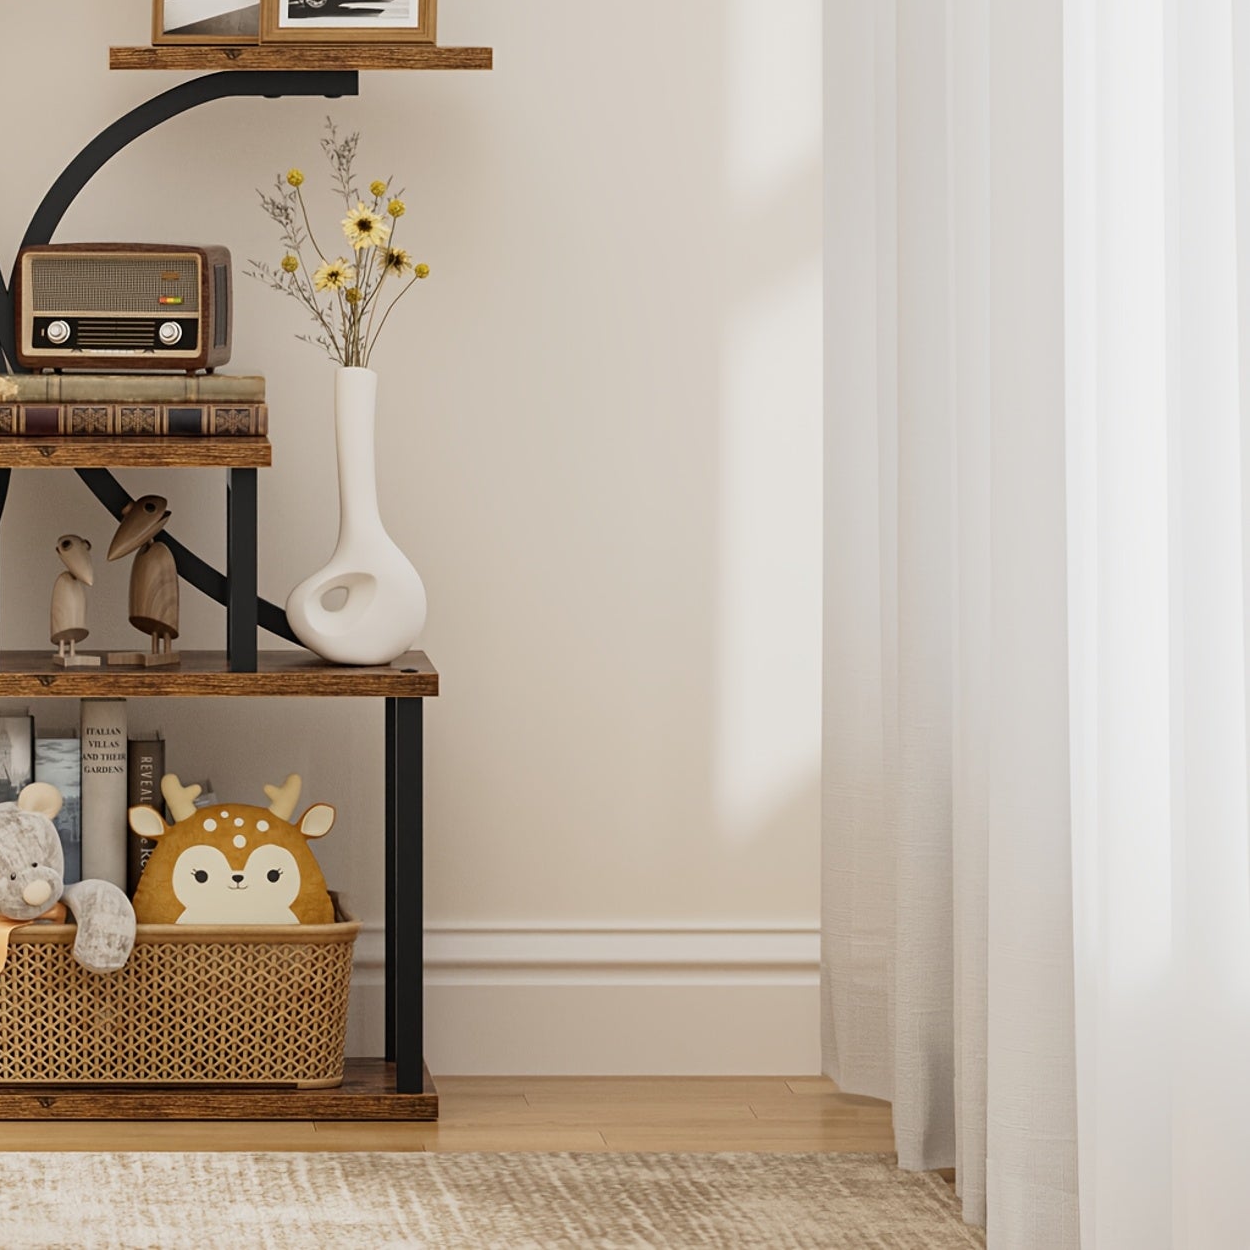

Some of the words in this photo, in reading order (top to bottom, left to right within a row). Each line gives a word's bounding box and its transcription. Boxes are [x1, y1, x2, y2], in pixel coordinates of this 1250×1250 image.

[86, 727, 121, 735] ITALIAN
[88, 740, 120, 748] VILLAS
[82, 753, 99, 761] AND
[100, 753, 126, 761] THEIR
